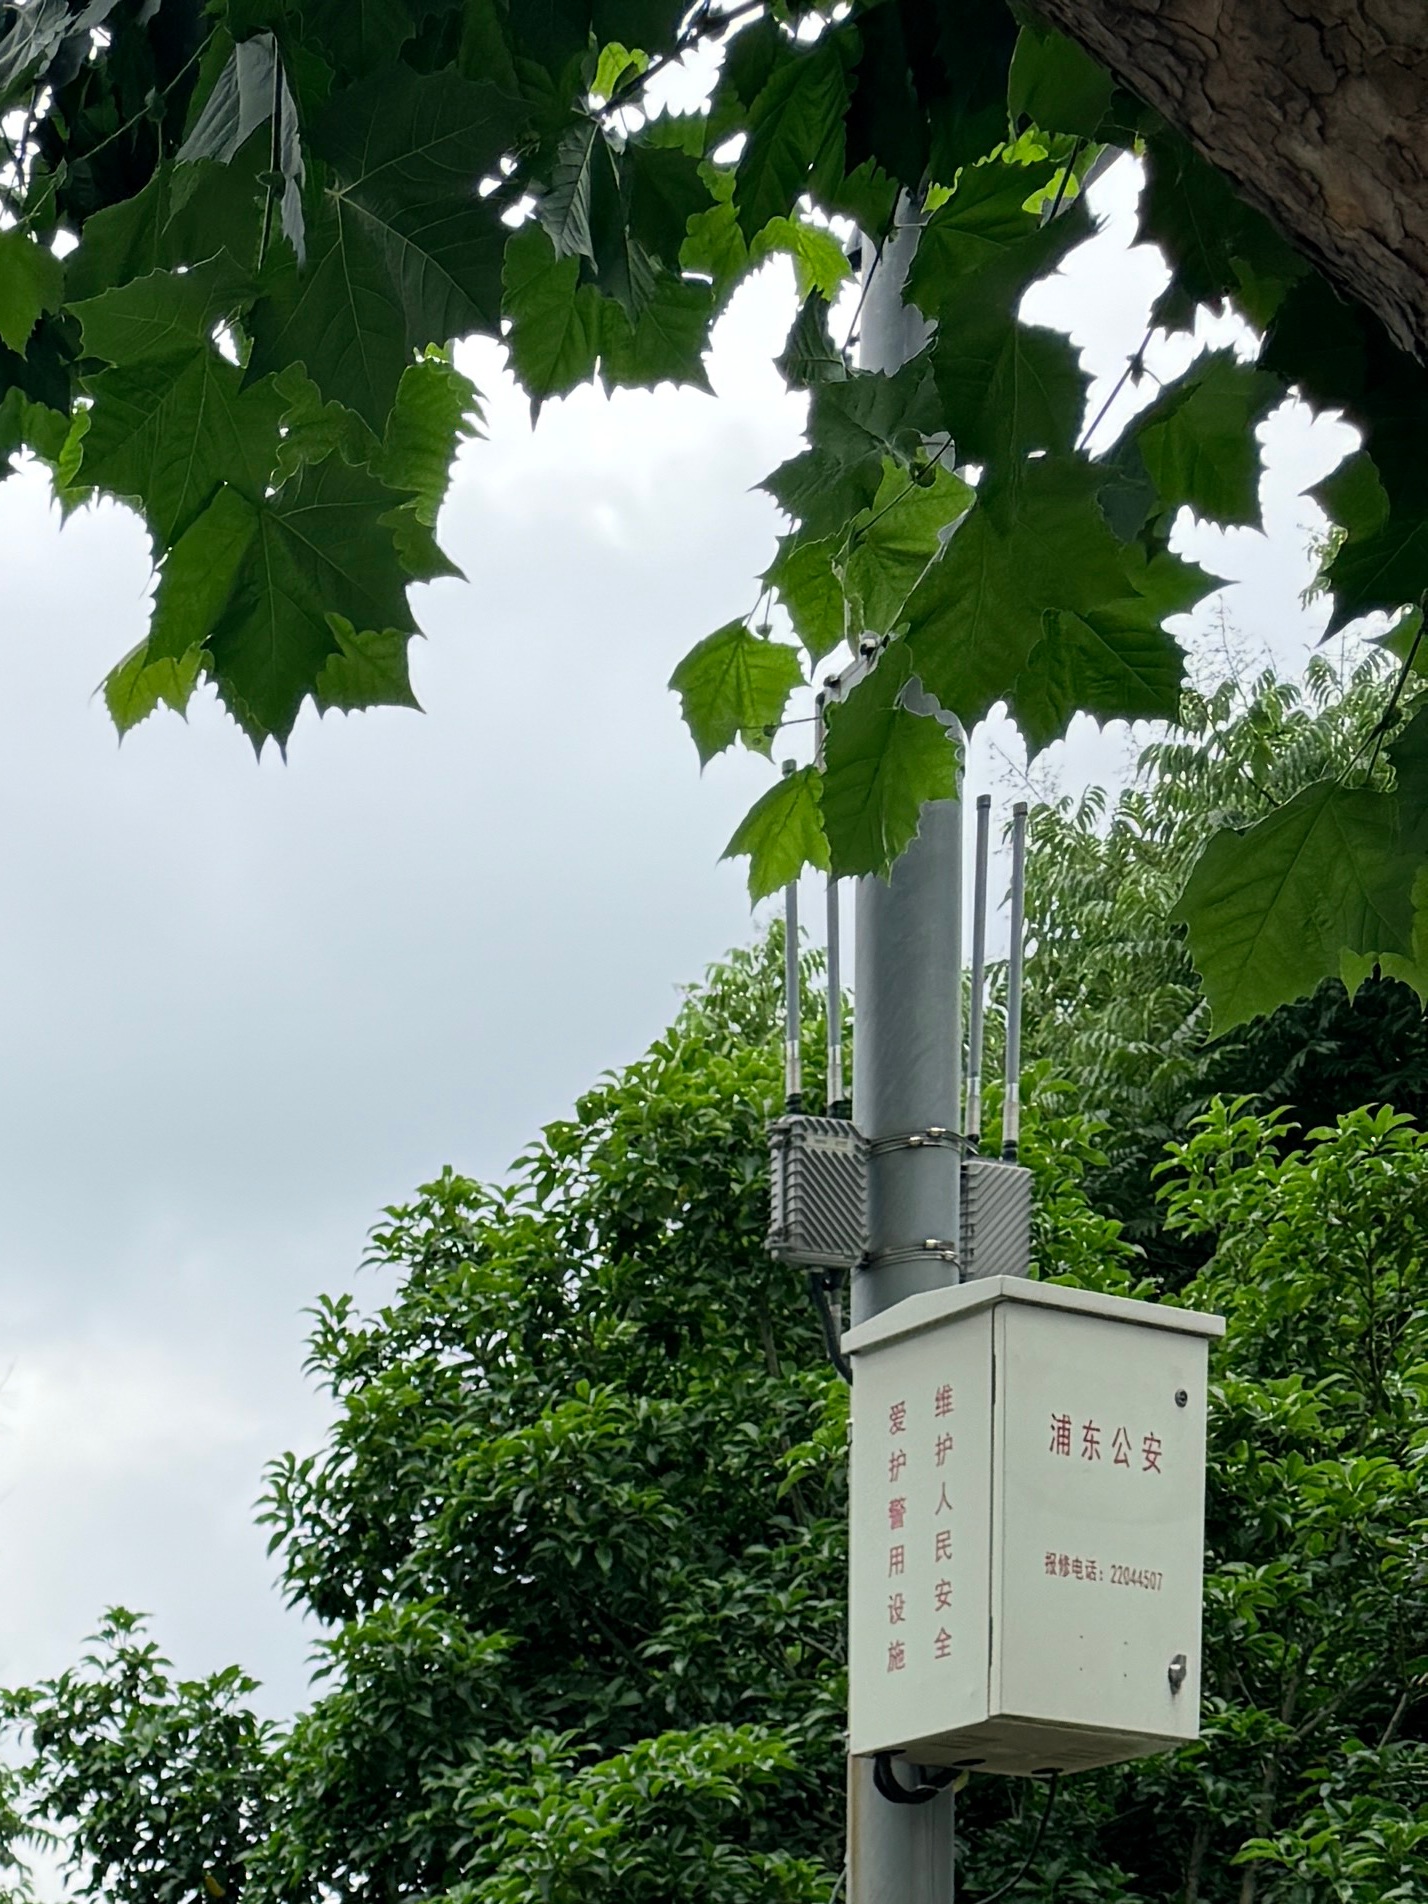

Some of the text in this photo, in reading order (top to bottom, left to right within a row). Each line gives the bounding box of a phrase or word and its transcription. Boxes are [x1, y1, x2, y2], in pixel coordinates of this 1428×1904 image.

[887, 1400, 907, 1674] 爱护警用设施
[934, 1384, 954, 1660] 维护人民安全
[1047, 1412, 1164, 1474] 浦东公安
